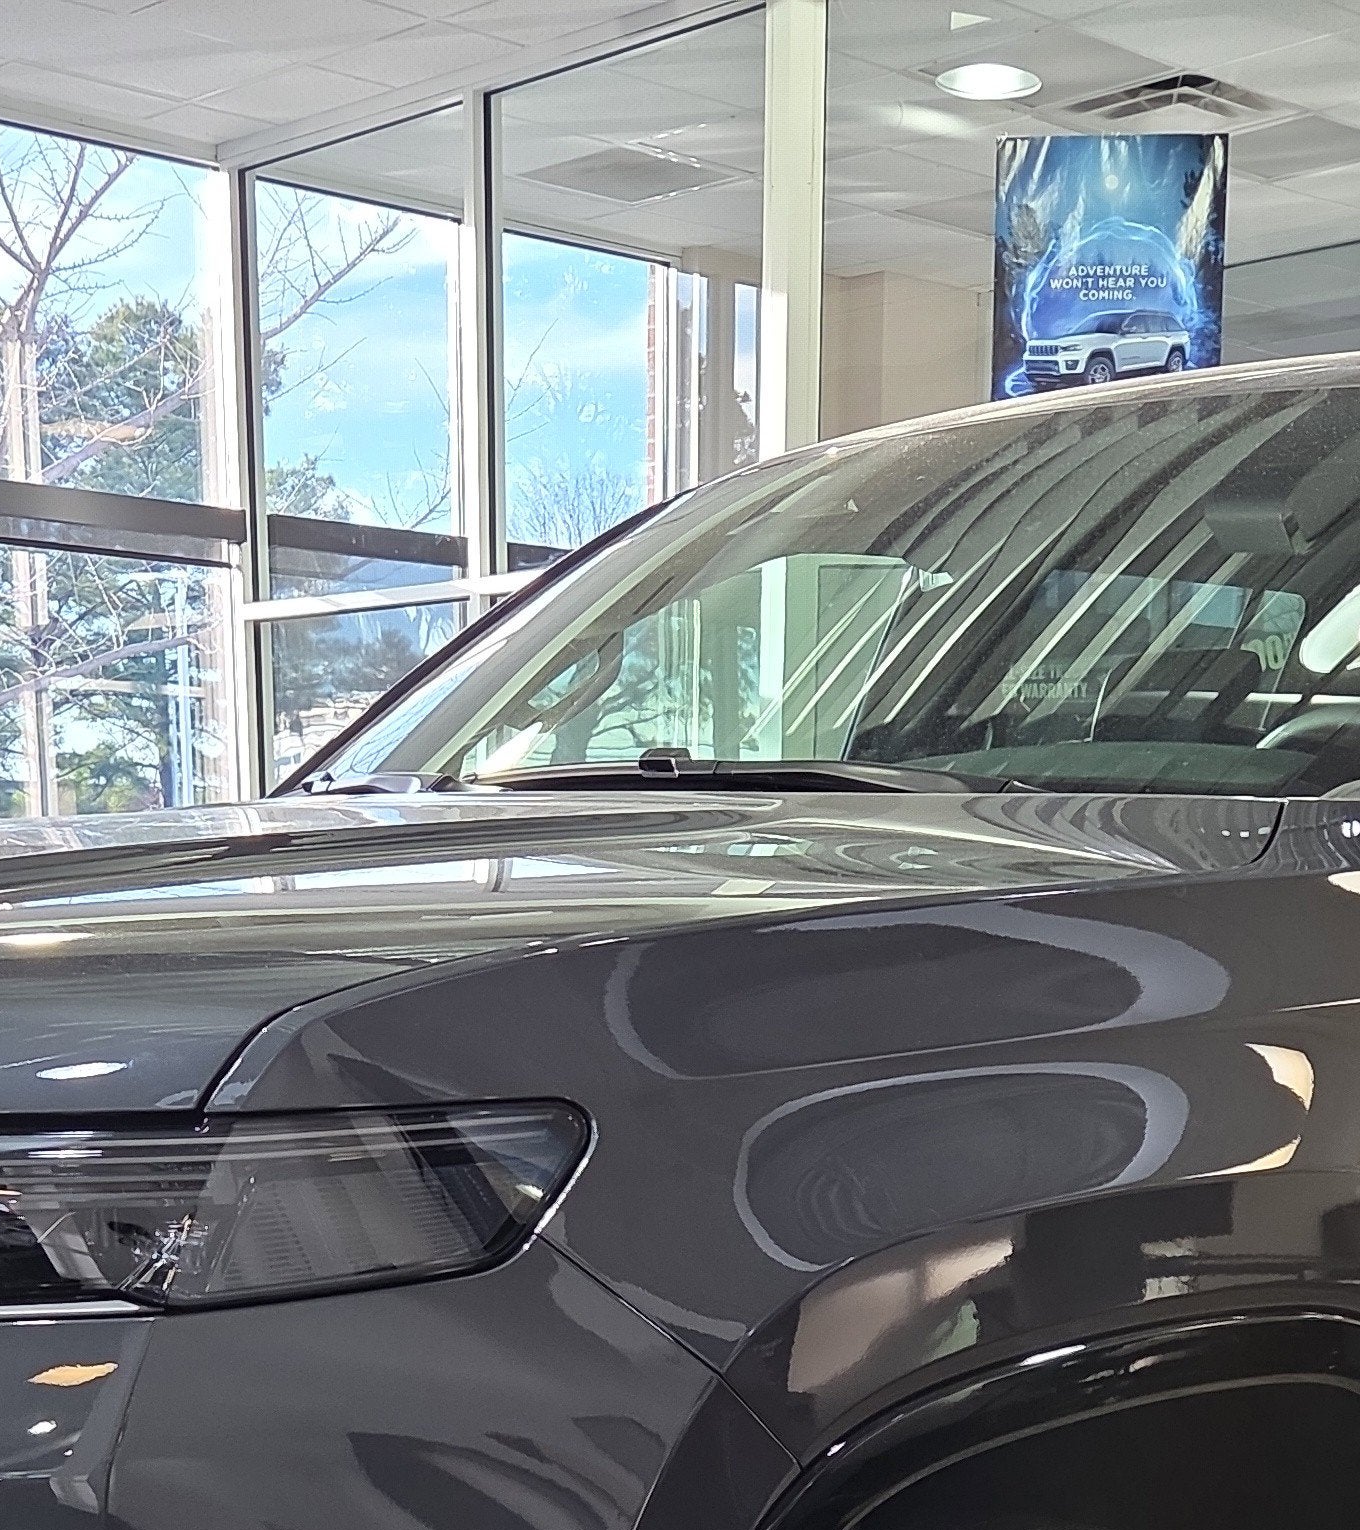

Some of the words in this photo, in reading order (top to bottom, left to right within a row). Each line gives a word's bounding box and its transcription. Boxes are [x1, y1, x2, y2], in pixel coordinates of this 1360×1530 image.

[1068, 265, 1149, 277] ADVENTURE
[1049, 278, 1094, 289] WON'T
[1098, 277, 1135, 288] HEAR
[1139, 276, 1167, 288] YOU
[1079, 289, 1136, 301] COMING.
